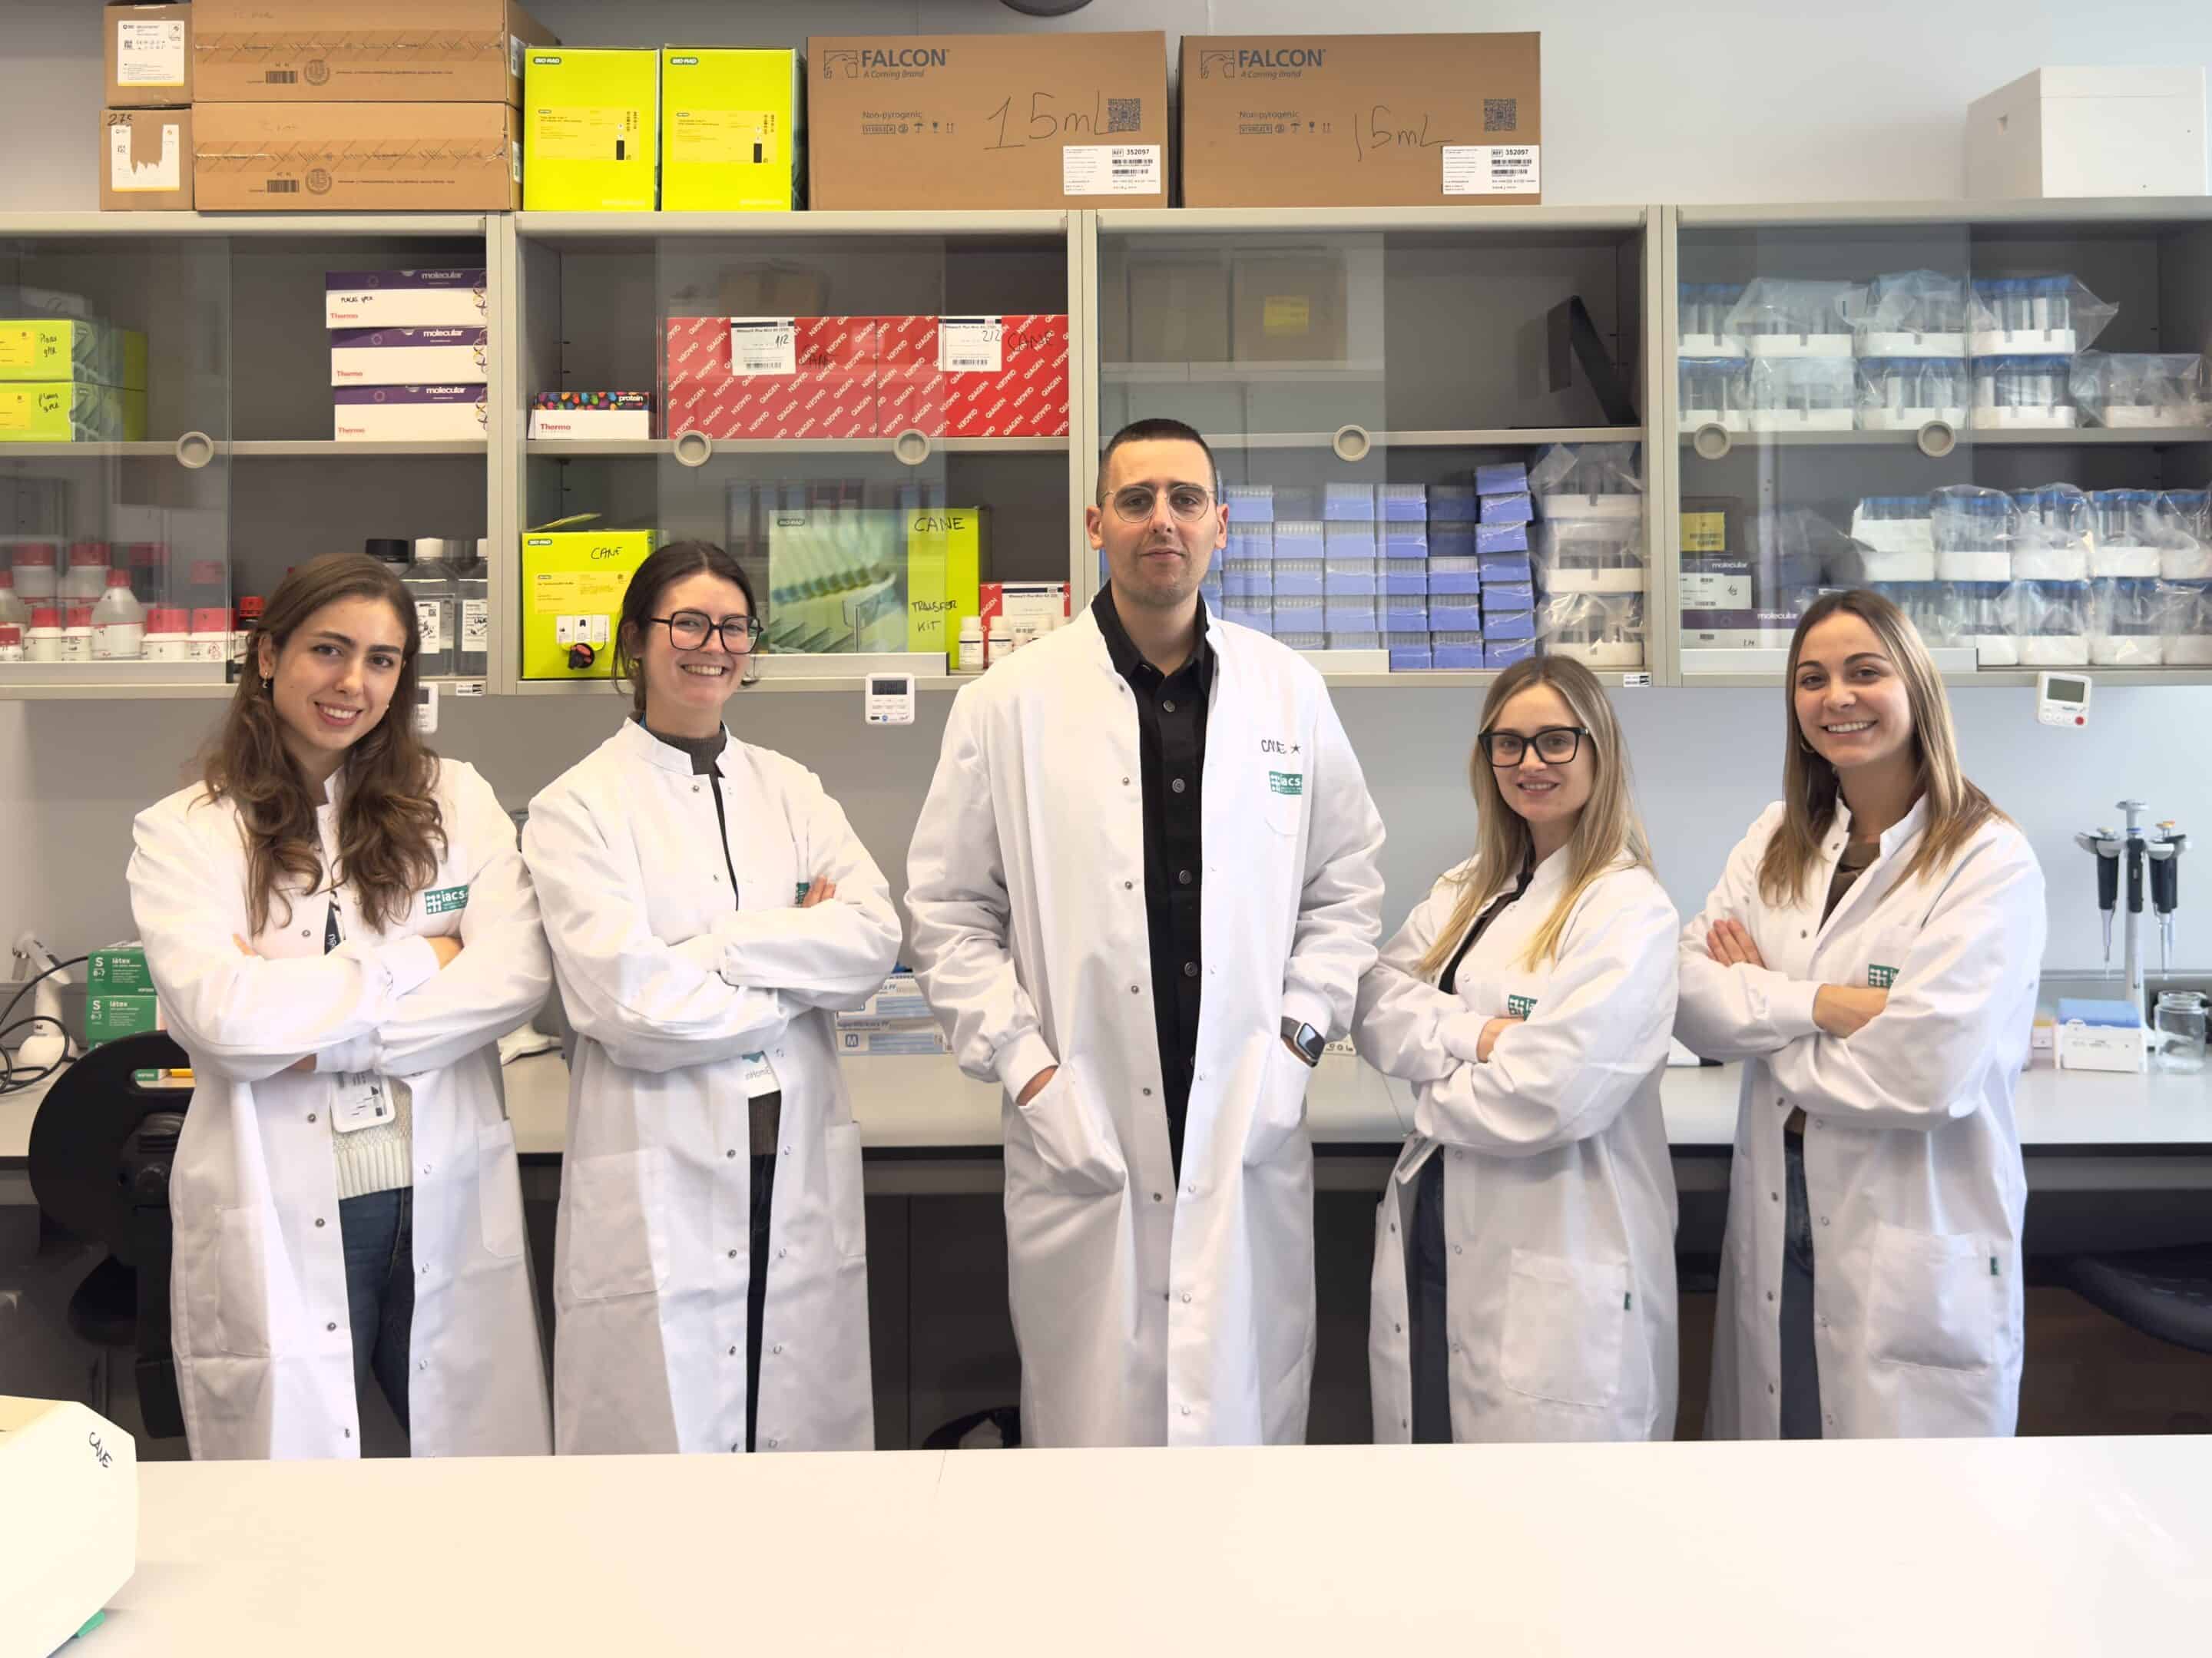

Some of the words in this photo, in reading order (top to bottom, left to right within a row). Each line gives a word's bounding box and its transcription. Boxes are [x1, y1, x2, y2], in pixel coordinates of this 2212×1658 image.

[862, 48, 946, 68] FALCON
[1239, 48, 1322, 68] FALCON
[707, 331, 727, 353] QIAGEN
[854, 322, 876, 343] QIAGEN
[915, 329, 936, 350] QIAGEN
[677, 342, 699, 363] QIAGEN
[826, 333, 847, 354] QIAGEN
[887, 340, 907, 362] QIAGEN
[695, 359, 717, 381] QIAGEN
[816, 361, 836, 381] QIAGEN
[844, 350, 865, 371] QIAGEN
[904, 357, 925, 379] QIAGEN
[1024, 358, 1045, 379] QIAGEN
[667, 370, 688, 392] QIAGEN
[713, 376, 734, 398] QIAGEN
[787, 372, 808, 393] QIAGEN
[833, 378, 855, 399] QIAGEN
[922, 374, 942, 395] QIAGEN
[995, 369, 1016, 390] QIAGEN
[1041, 376, 1062, 397] QIAGEN
[685, 387, 707, 409] QIAGEN
[760, 382, 781, 404] QIAGEN
[805, 389, 826, 411] QIAGEN
[894, 385, 915, 406] QIAGEN
[968, 381, 988, 401] QIAGEN
[1014, 387, 1034, 408] QIAGEN
[731, 394, 752, 415] QIAGEN
[777, 399, 798, 422] QIAGEN
[851, 395, 872, 416] QIAGEN
[939, 392, 960, 412] QIAGEN
[985, 398, 1007, 419] QIAGEN
[703, 405, 724, 425] QIAGEN
[749, 411, 770, 432] QIAGEN
[823, 406, 843, 427] QIAGEN
[912, 402, 932, 424] QIAGEN
[957, 409, 978, 429] QIAGEN
[1031, 404, 1051, 425] QIAGEN
[883, 414, 904, 435] QIAGEN
[1003, 414, 1025, 435] QIAGEN
[914, 517, 965, 532] CANE
[442, 891, 465, 902] iacs
[95, 957, 104, 967] S
[93, 1000, 101, 1010] S
[847, 1035, 858, 1046] M
